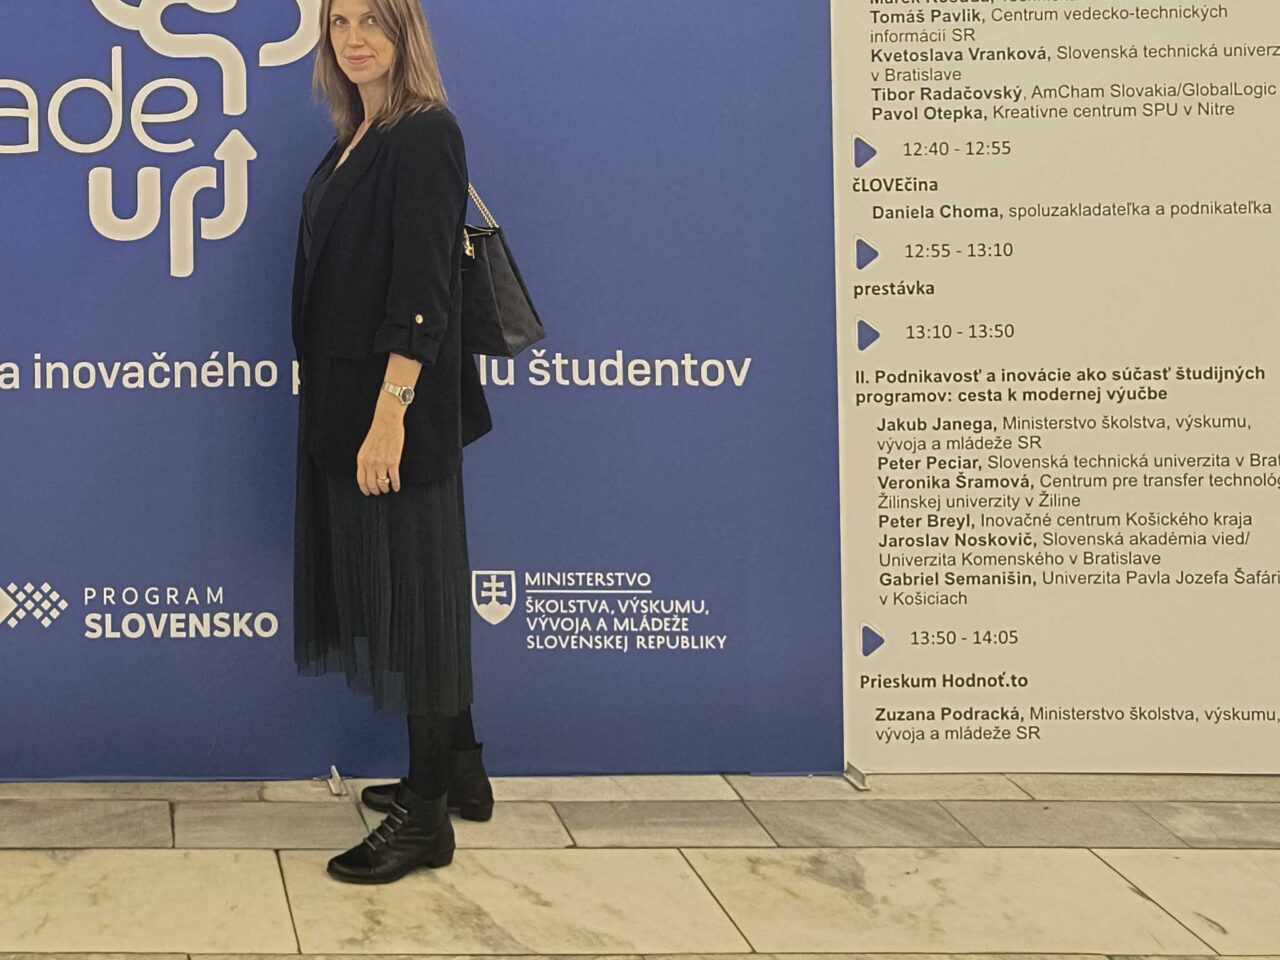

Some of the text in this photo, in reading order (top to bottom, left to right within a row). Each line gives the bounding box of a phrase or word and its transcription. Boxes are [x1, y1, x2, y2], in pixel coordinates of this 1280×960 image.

[869, 4, 1228, 24] Tomáš Pavlik, Centrum vedecko-technických
[952, 28, 976, 42] SR
[871, 48, 963, 63] Kvetoslava
[968, 46, 1051, 62] Vranková,
[1057, 44, 1138, 60] Slovenská
[1143, 43, 1218, 58] technická
[885, 67, 962, 82] Bratislave
[871, 82, 1277, 103] Tibor Radačovský, AmCham Slovakia/GlobalLogic
[872, 102, 1235, 123] Pavol Otepka, Kreatívne centrum SPU Nitre
[903, 141, 1011, 156] 12:40 12:55
[852, 176, 938, 192] čLOVEčina
[88, 129, 257, 277] up
[872, 200, 1272, 221] Daniela Choma, spoluzakladateľka podnikateľka
[905, 242, 1013, 258] 12:55 13:10
[854, 280, 935, 299] prestávka
[906, 324, 1014, 339] 13:10 13:50
[34, 351, 277, 389] inovačného
[529, 349, 752, 386] študentov
[875, 365, 1265, 384] Podnikavosť inovácie ako súčasť študijných
[856, 386, 1168, 407] programov: cesta modernej výučbe
[876, 414, 1251, 434] Jakub Janega, Ministerstvo školstva, výskumu,
[877, 435, 1042, 454] vývoja mládeže SR
[878, 453, 1230, 472] Peter Peciar, Slovenská technická univerzita
[877, 471, 1280, 491] Veronika Šramová, Centrum pre transfer technoló
[878, 490, 1081, 512] Žilinskej univerzity Žiline
[879, 512, 1252, 531] Peter Breyl, Inovačné centrum Košického kraja
[878, 533, 949, 548] Jaroslav
[955, 532, 1037, 548] Noskovič,
[1043, 532, 1124, 546] Slovenská
[1129, 531, 1207, 546] akadémia
[879, 551, 1161, 567] Univerzita Komenského Bratislave
[525, 572, 651, 586] MINISTERSTVO
[879, 572, 939, 586] Gabriel
[944, 571, 1037, 587] Semanišin,
[1042, 570, 1120, 585] Univerzita
[1126, 570, 1170, 584] Pavla
[1175, 570, 1228, 584] Jozefa
[84, 586, 223, 605] PROGRAM
[893, 591, 967, 606] Košiciach
[525, 596, 709, 615] ŠKOLSTVA, VÝSKUMU,
[84, 612, 278, 639] SLOVENSKO
[526, 614, 689, 634] VÝVOJA A MLÁDEŽE
[527, 635, 727, 653] SLOVENSKEJ REPUBLIKY
[911, 630, 1018, 645] 13:50 14:05
[860, 671, 1028, 689] Prieskum Hodnoť.to
[875, 708, 935, 722] Zuzana
[941, 706, 1024, 722] Podracká,
[1030, 706, 1124, 720] Ministerstvo
[1130, 706, 1199, 722] školstva,
